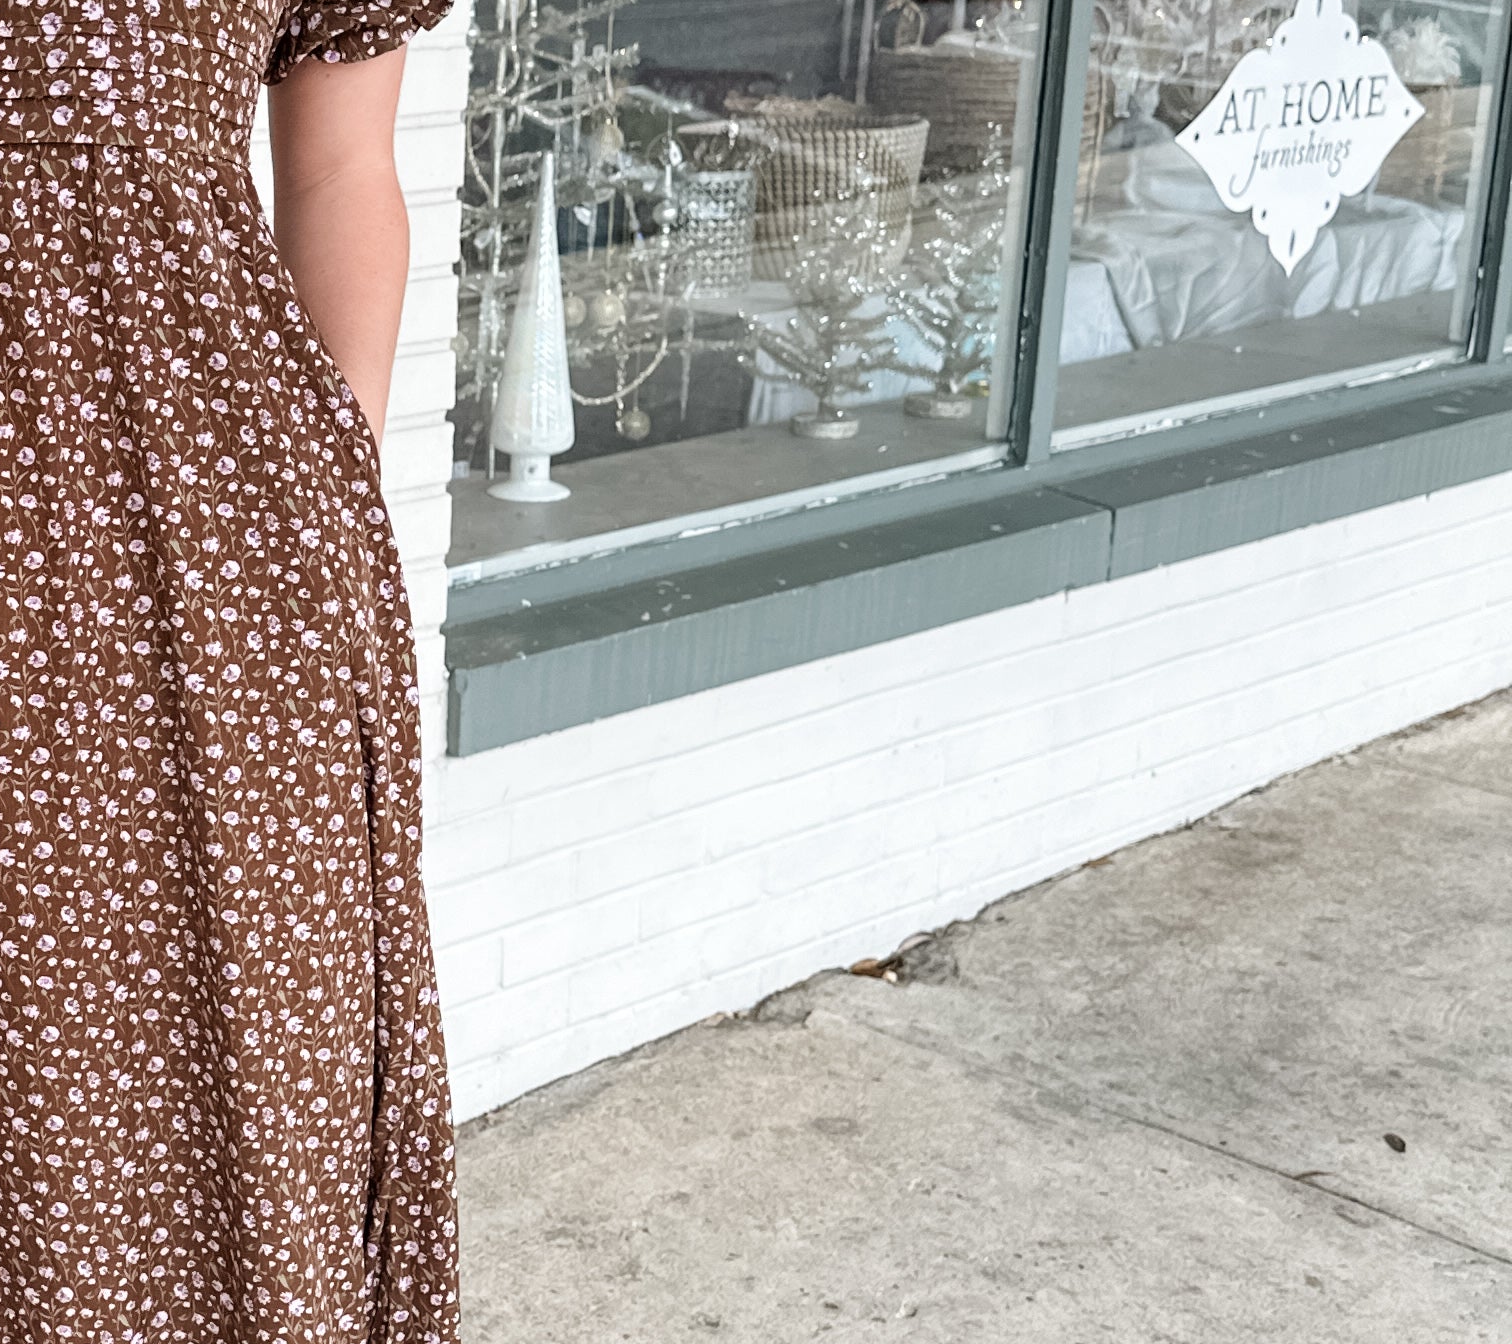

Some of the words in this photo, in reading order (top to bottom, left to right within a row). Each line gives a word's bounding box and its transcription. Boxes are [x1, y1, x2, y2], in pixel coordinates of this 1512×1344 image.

[1215, 87, 1266, 135] AT
[1279, 75, 1388, 128] HOME
[1229, 124, 1352, 198] furnishings
